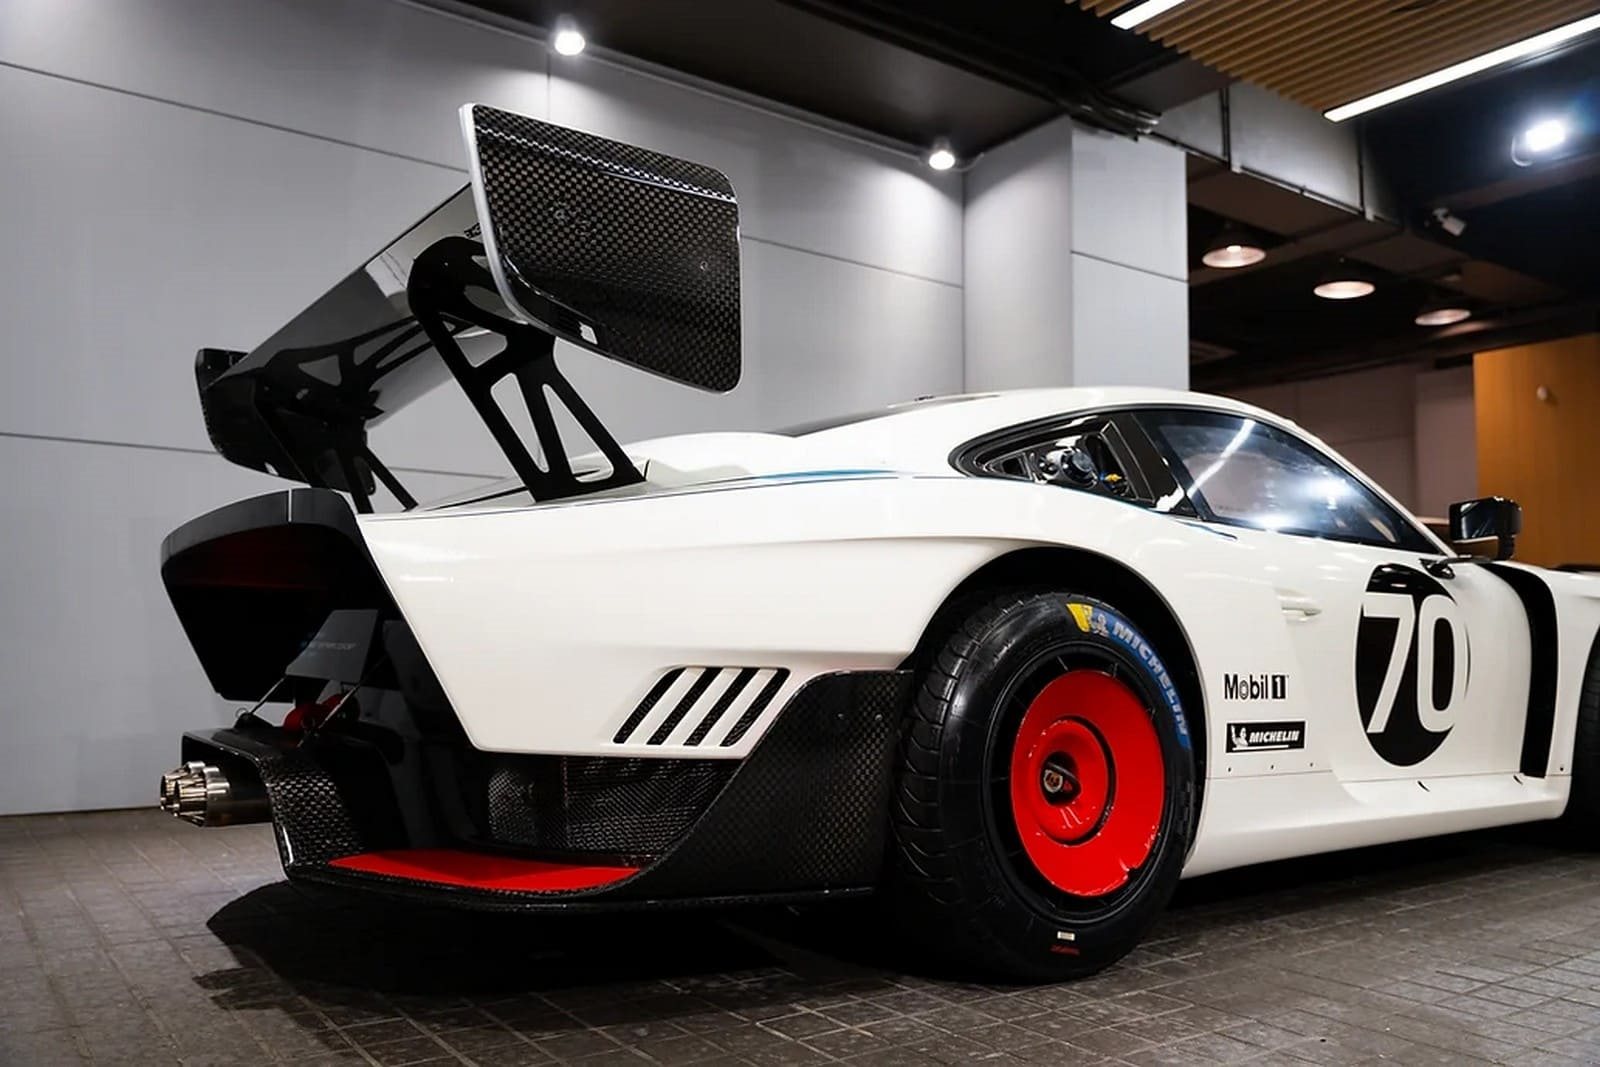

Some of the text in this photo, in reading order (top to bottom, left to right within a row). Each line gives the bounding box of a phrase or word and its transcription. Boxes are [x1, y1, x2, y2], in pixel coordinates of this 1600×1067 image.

[1112, 621, 1188, 736] MICHELIN
[1224, 673, 1286, 700] Mobil 1
[1360, 592, 1468, 734] 70
[1249, 730, 1301, 743] MICHELIN
